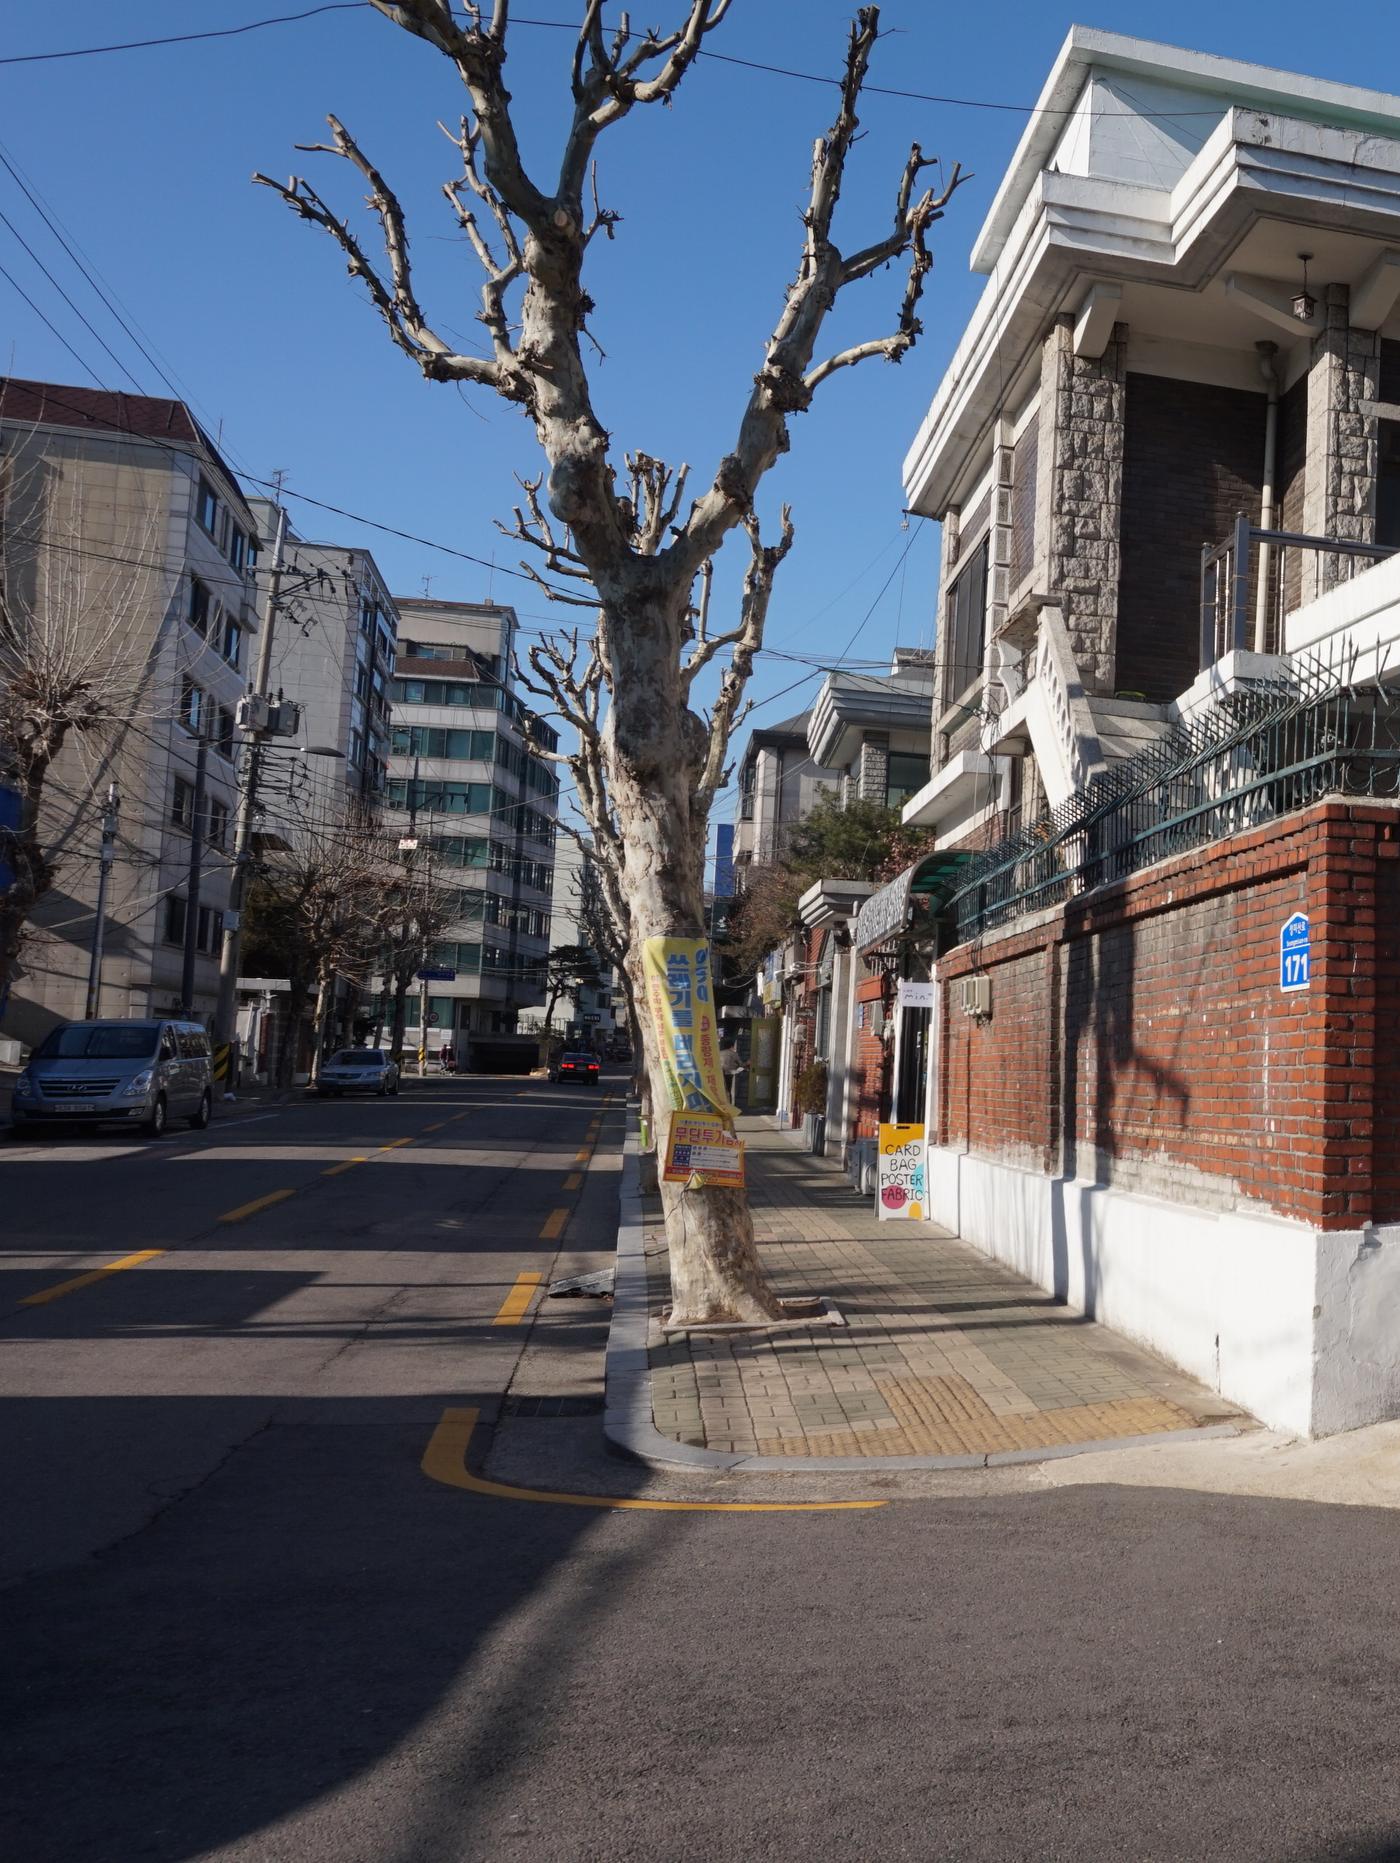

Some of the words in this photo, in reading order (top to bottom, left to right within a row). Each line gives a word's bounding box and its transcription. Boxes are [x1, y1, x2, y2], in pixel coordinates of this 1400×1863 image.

[1285, 953, 1308, 983] 171
[667, 952, 695, 1028] 쓰레기를
[885, 1144, 921, 1157] CARD
[890, 1158, 917, 1172] BAG
[881, 1173, 924, 1186] POSTER
[881, 1186, 924, 1201] FABRIC
